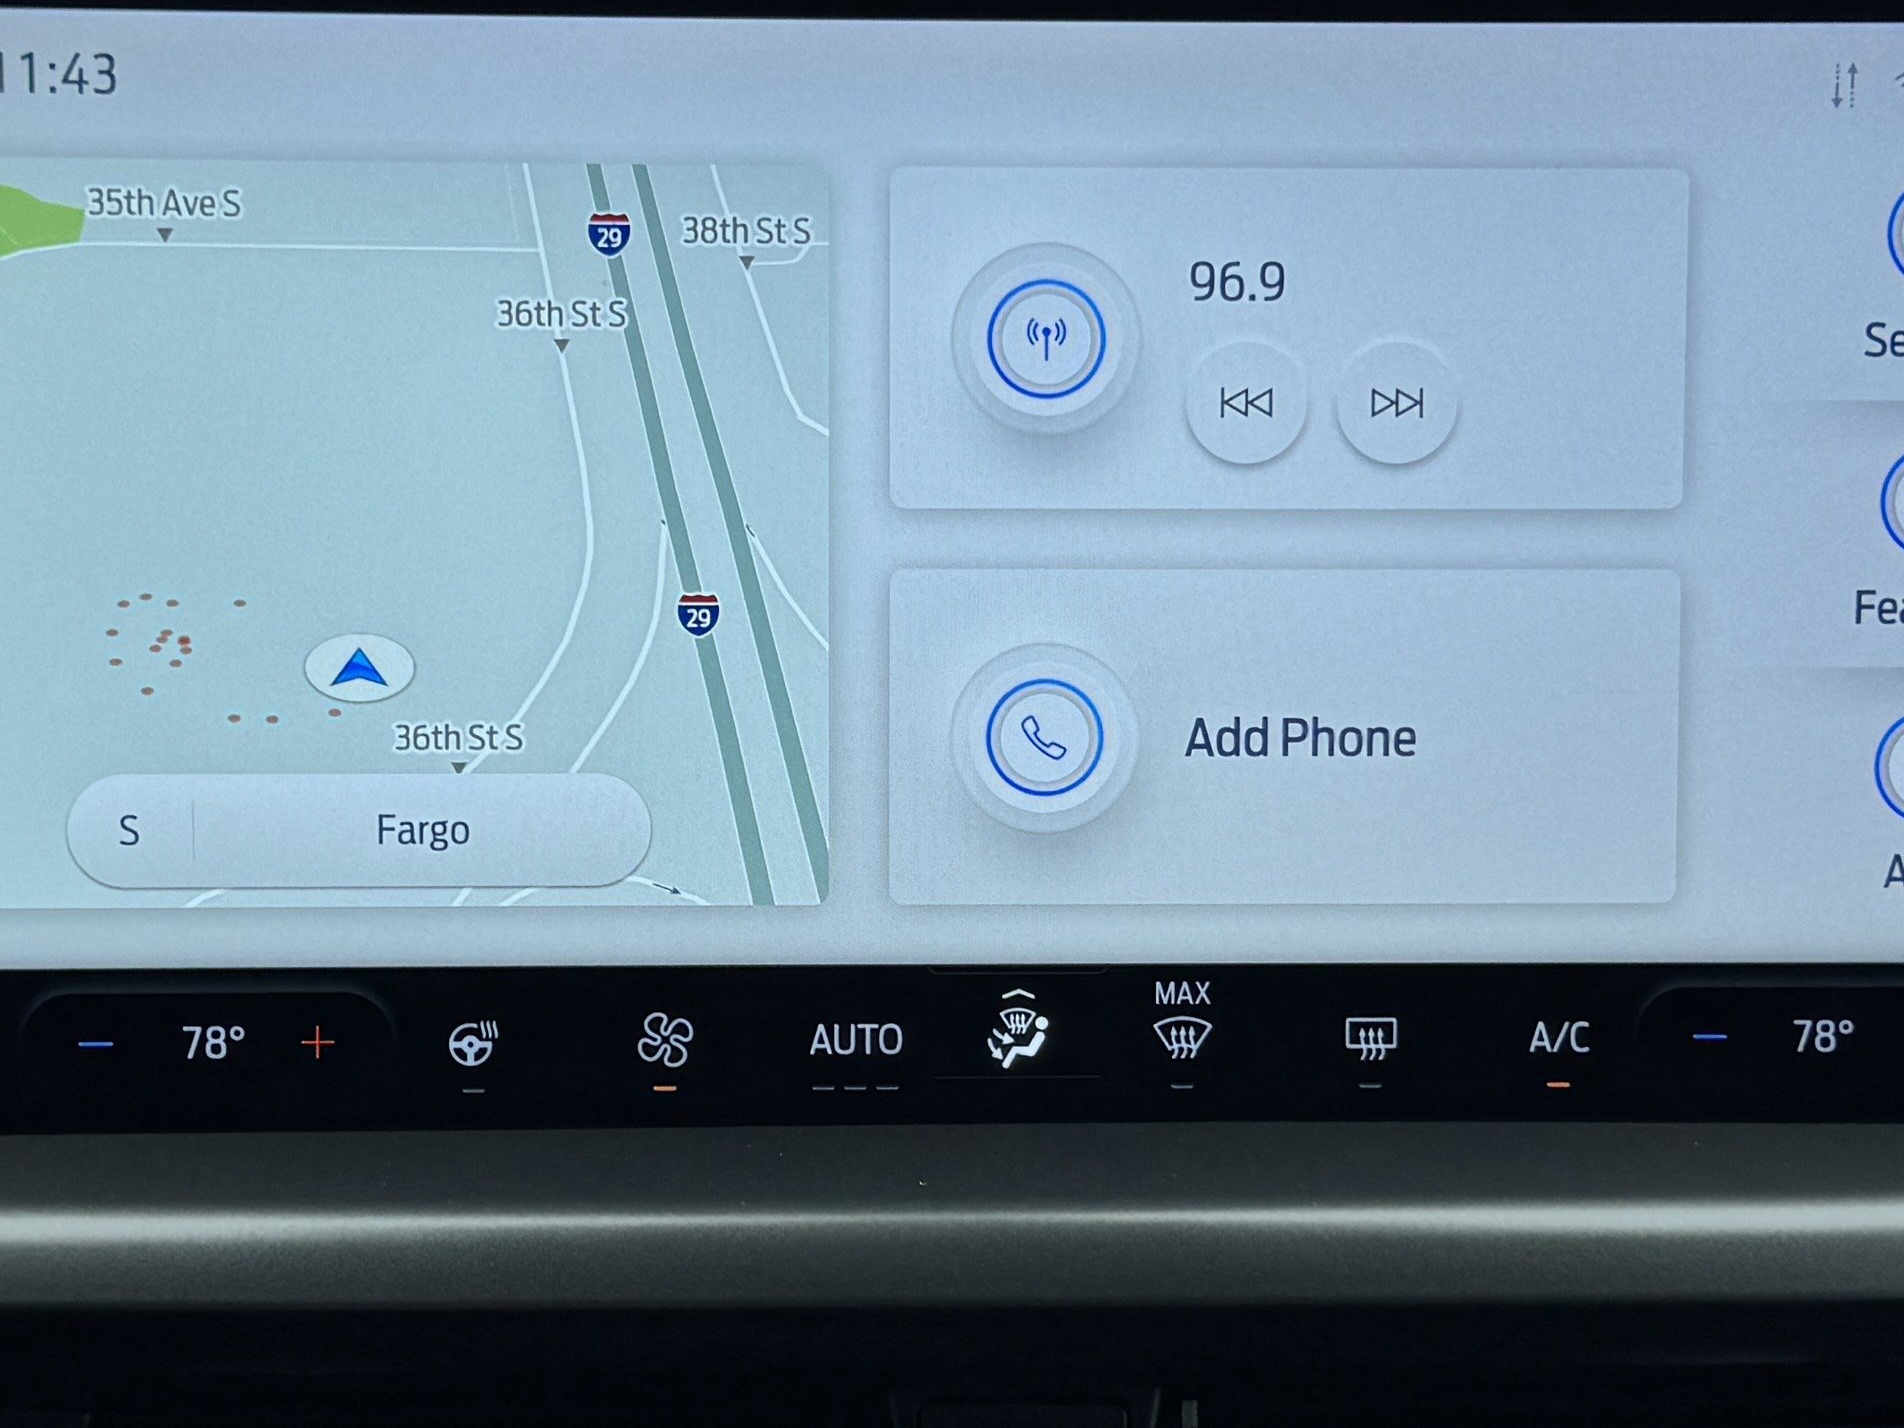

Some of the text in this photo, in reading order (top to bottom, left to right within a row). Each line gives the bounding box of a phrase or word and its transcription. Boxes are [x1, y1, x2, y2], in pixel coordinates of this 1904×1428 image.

[87, 187, 241, 218] 35th Ave S
[596, 227, 623, 249] 29
[682, 215, 811, 245] 38th St S
[1188, 260, 1287, 303] 96.9
[497, 299, 626, 328] 36th St S
[685, 607, 711, 630] 29
[394, 723, 523, 752] 36th St S
[1184, 716, 1418, 759] Add Phone
[118, 814, 141, 847] S
[377, 813, 471, 852] Fargo
[1154, 981, 1212, 1005] MAX
[181, 1024, 246, 1061] 78°
[809, 1022, 904, 1056] AUTO
[1529, 1019, 1592, 1054] A/C
[1792, 1019, 1856, 1054] 78°
